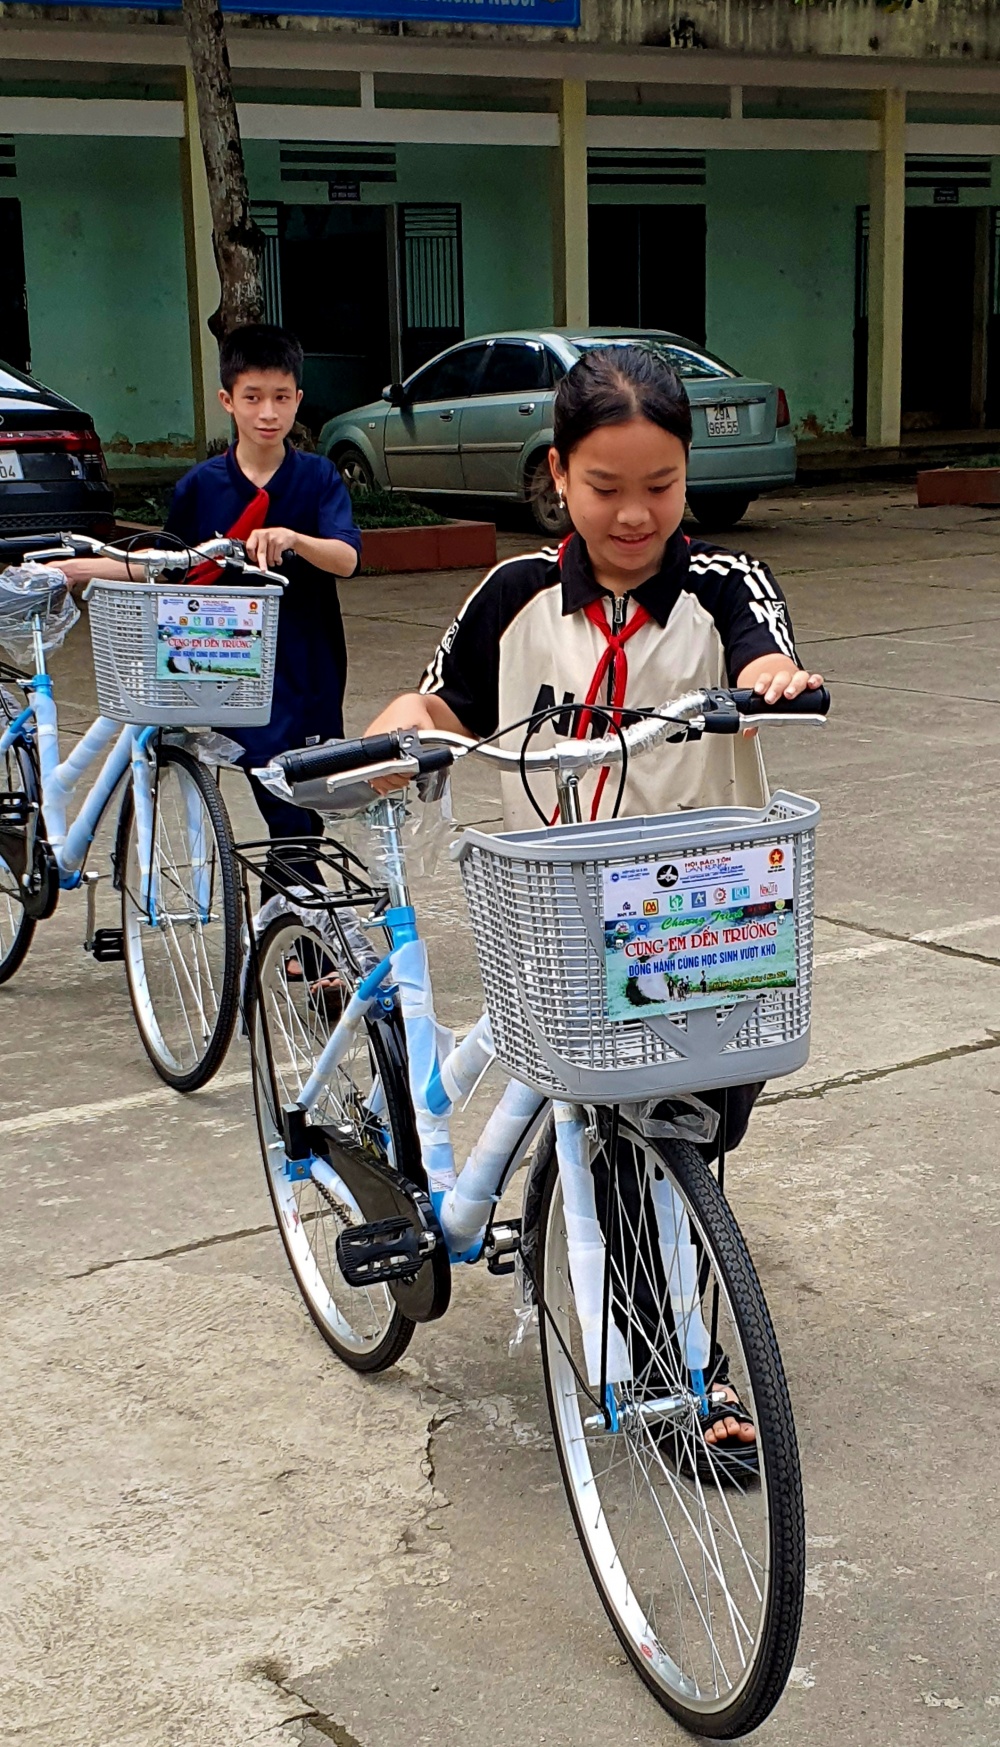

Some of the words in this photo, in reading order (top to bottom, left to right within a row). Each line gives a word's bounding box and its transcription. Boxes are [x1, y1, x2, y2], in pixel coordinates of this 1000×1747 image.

[715, 407, 730, 421] 29A
[625, 937, 664, 958] CÙNG
[668, 935, 686, 952] EM
[691, 925, 719, 949] ĐẾN
[723, 920, 778, 944] TRƯỜNG
[629, 961, 652, 977] ĐỒNG
[653, 959, 676, 974] HÀNH
[678, 956, 700, 971] CÙNG
[702, 953, 719, 969] HỌC
[720, 949, 738, 964] SINH
[740, 945, 759, 962] VƯỢT
